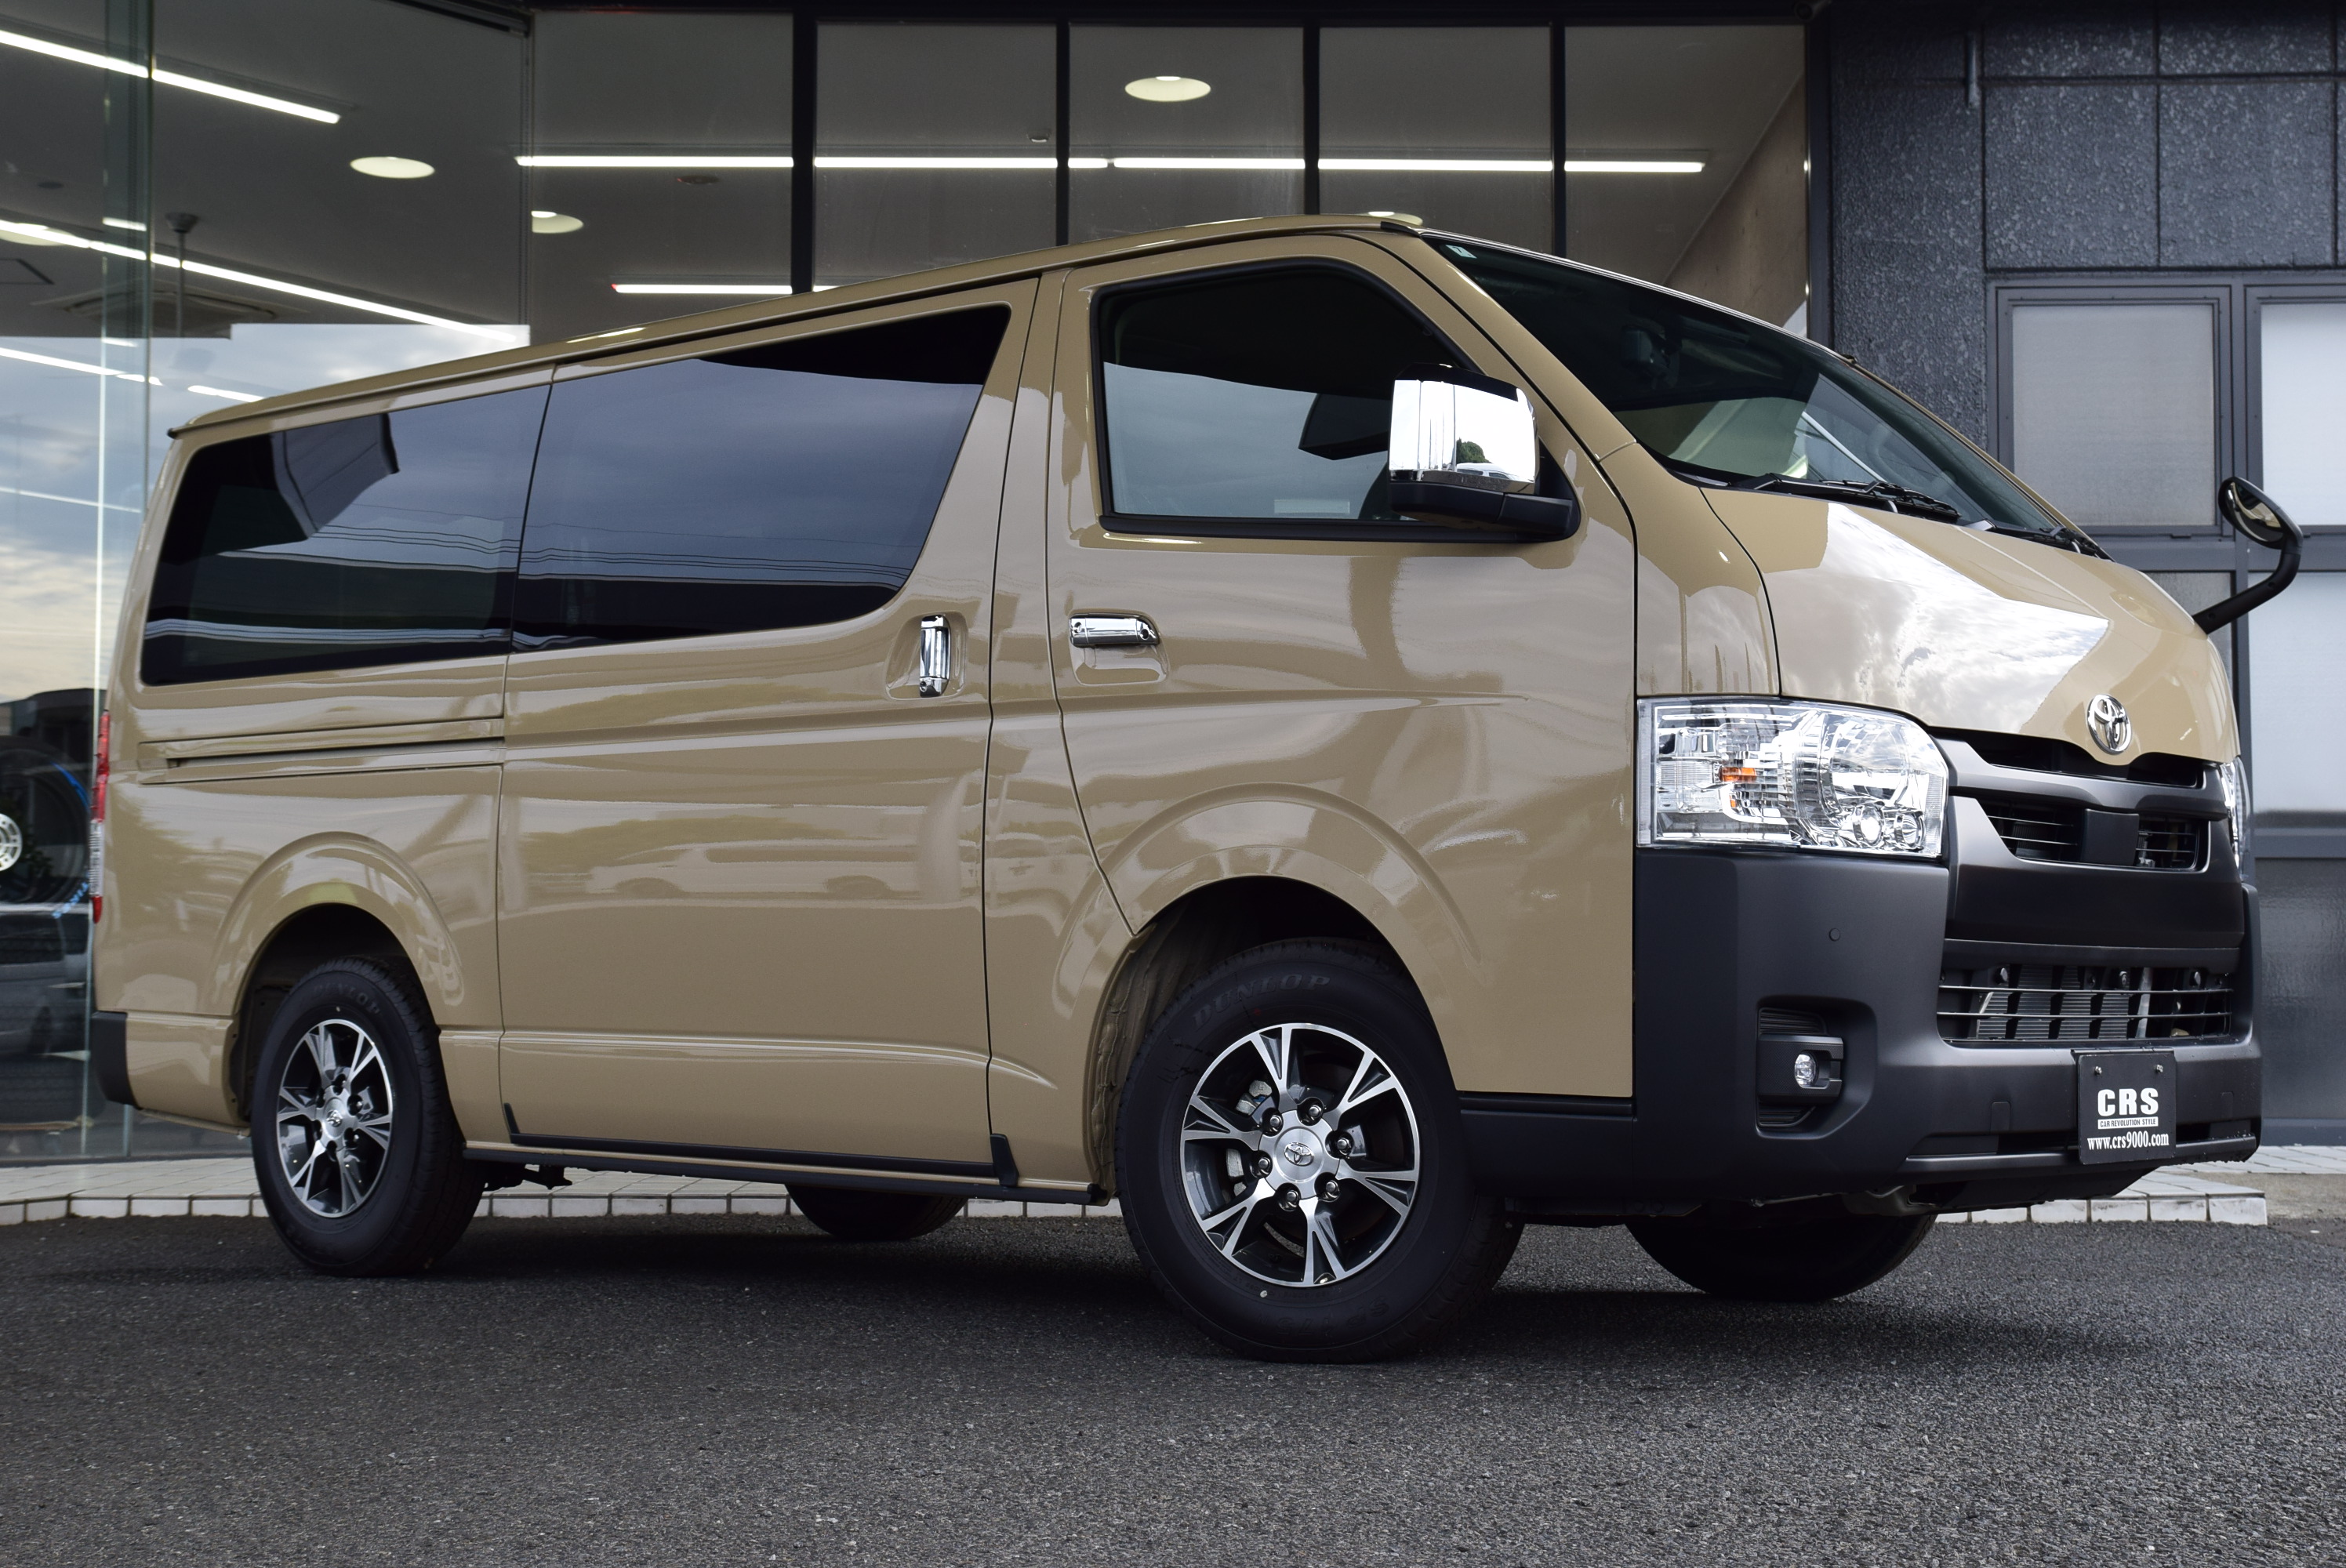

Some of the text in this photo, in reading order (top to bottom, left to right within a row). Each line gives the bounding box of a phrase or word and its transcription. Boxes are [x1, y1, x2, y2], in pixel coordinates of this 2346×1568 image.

[1193, 974, 1331, 1032] DUNLOP
[2097, 1087, 2159, 1116] CRS
[2086, 1131, 2170, 1150] www.crs9000.com
